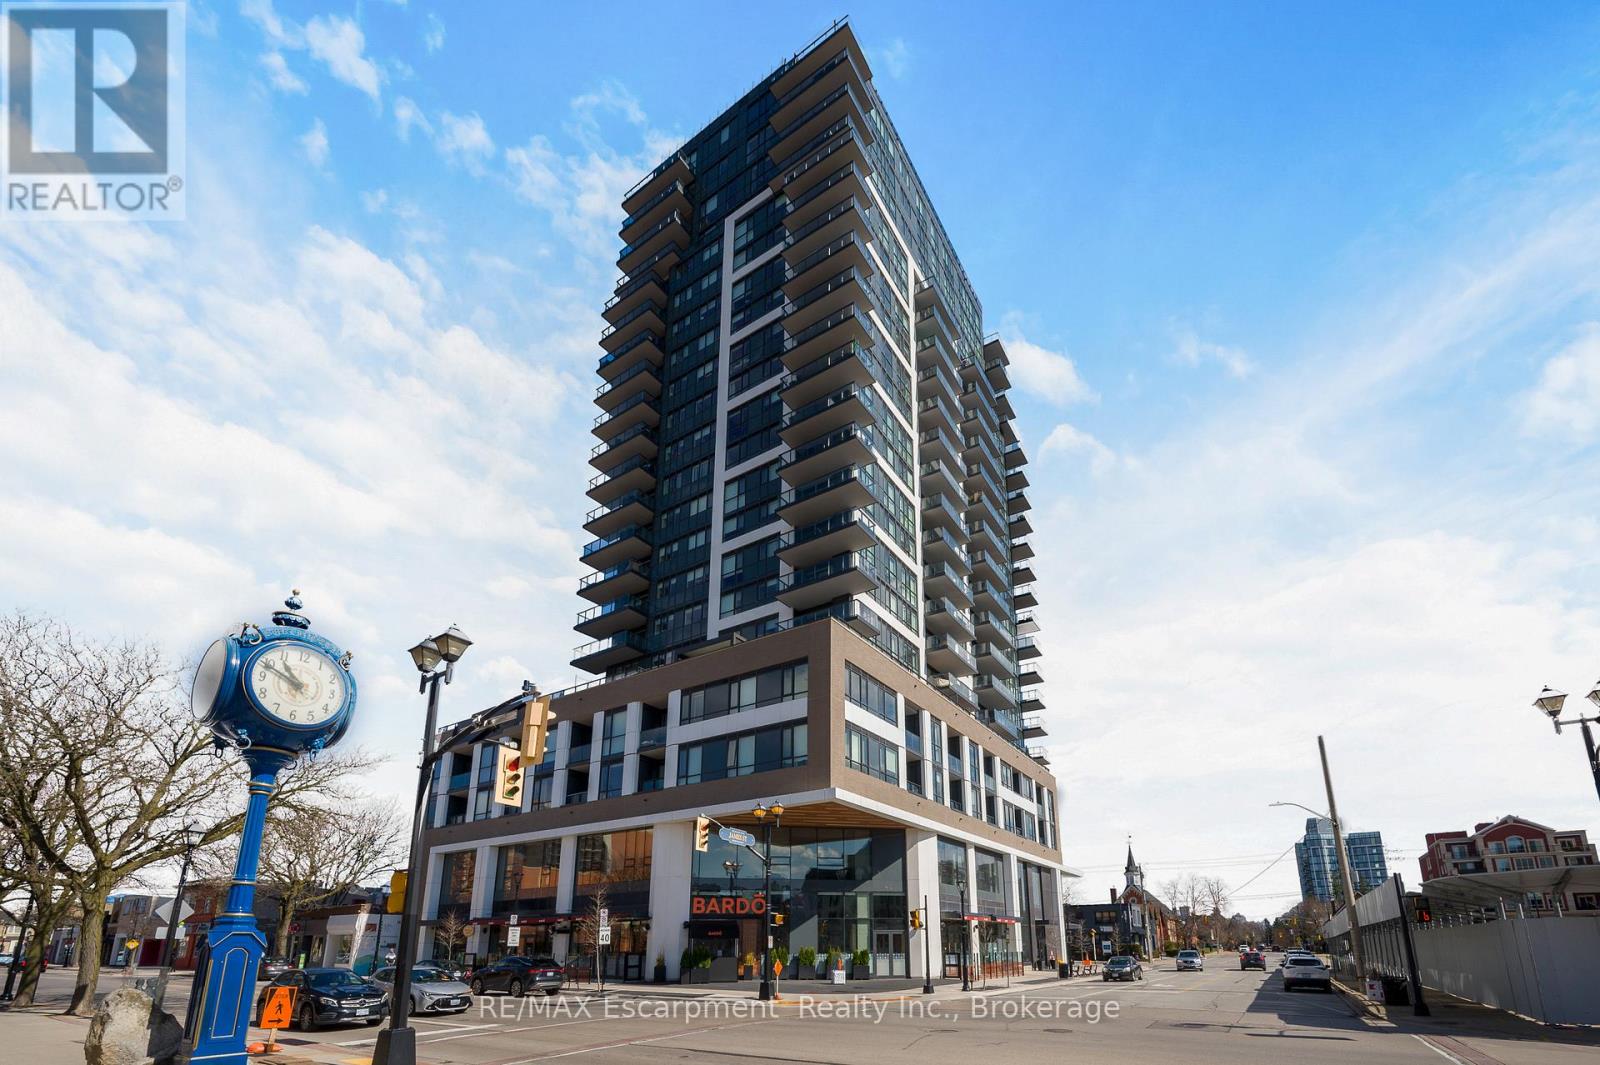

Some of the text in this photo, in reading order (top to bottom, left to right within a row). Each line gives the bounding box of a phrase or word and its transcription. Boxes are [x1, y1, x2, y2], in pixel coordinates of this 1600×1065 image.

[280, 650, 289, 662] 11
[299, 651, 311, 664] 12
[258, 670, 267, 682] 9
[328, 673, 337, 685] 2
[258, 687, 267, 699] 8
[328, 689, 336, 700] 3
[272, 703, 281, 714] 7
[321, 703, 329, 714] 4
[289, 709, 297, 721] 6
[306, 710, 315, 721] 5
[599, 933, 610, 943] 40
